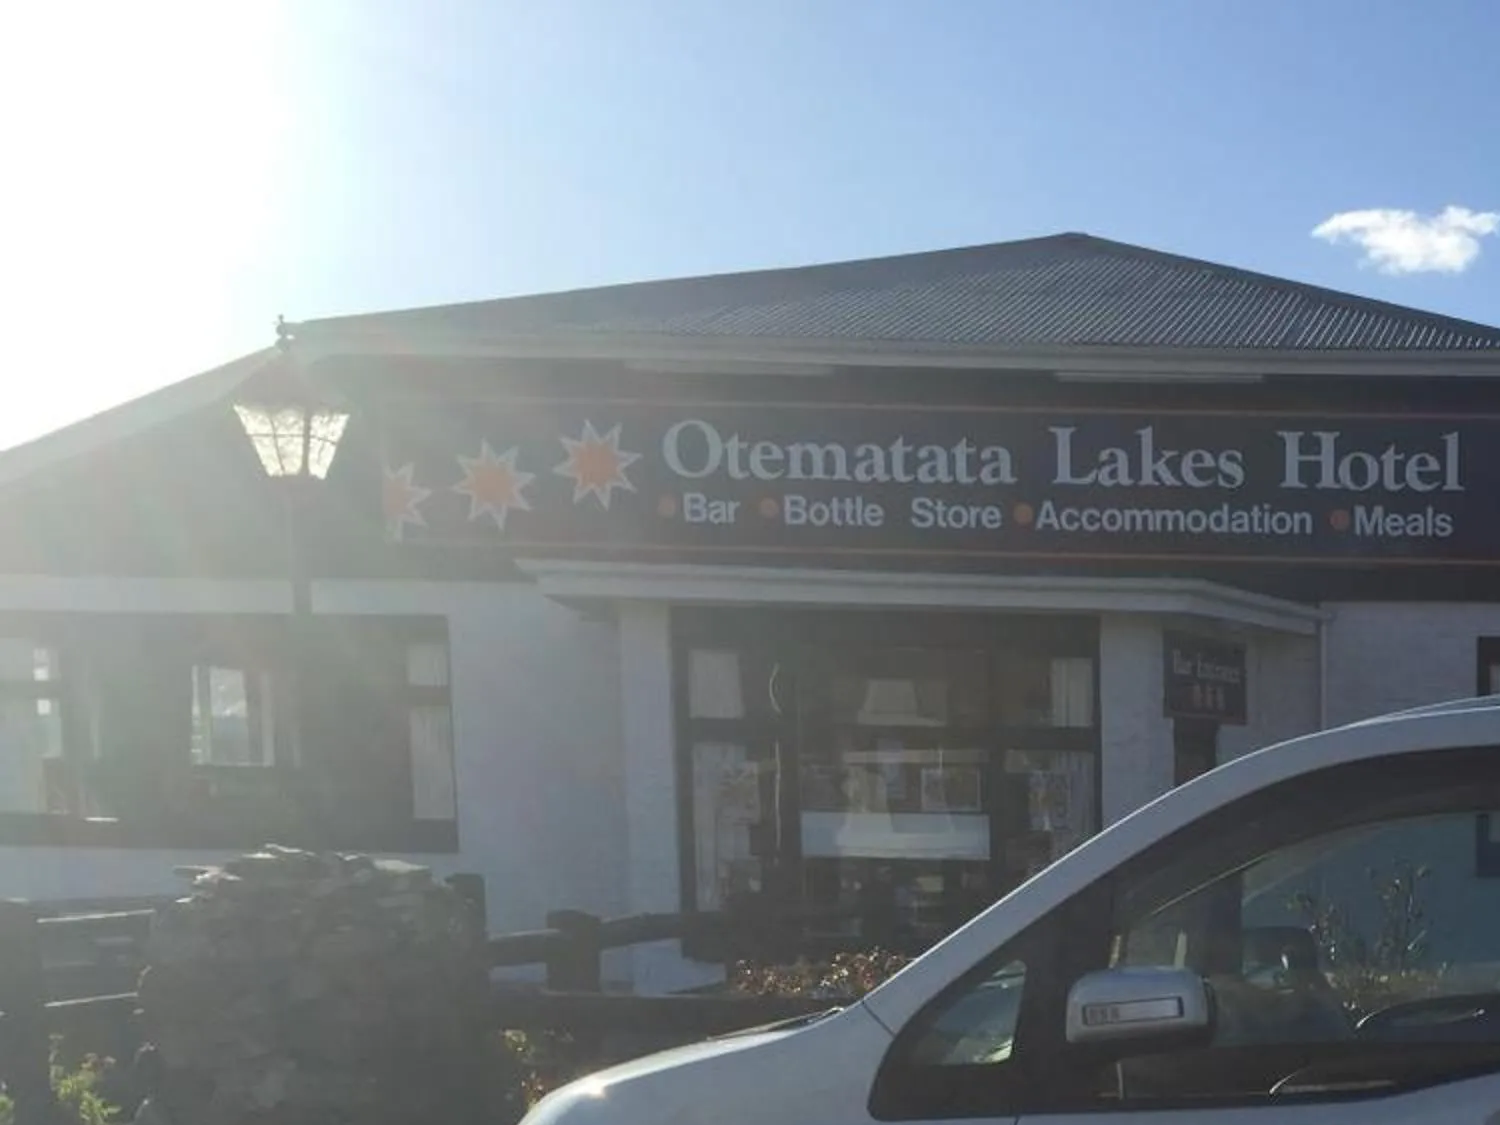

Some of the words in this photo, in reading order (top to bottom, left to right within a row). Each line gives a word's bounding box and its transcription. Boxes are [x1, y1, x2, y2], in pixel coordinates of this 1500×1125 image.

[661, 419, 1016, 486] Otematata
[1048, 425, 1246, 489] Lakes
[1278, 430, 1465, 492] Hotel
[682, 492, 738, 523] Bar
[784, 493, 884, 527] Bottle
[910, 496, 1002, 530] Store
[1035, 500, 1313, 535] Accommodation
[1352, 505, 1454, 537] Meals
